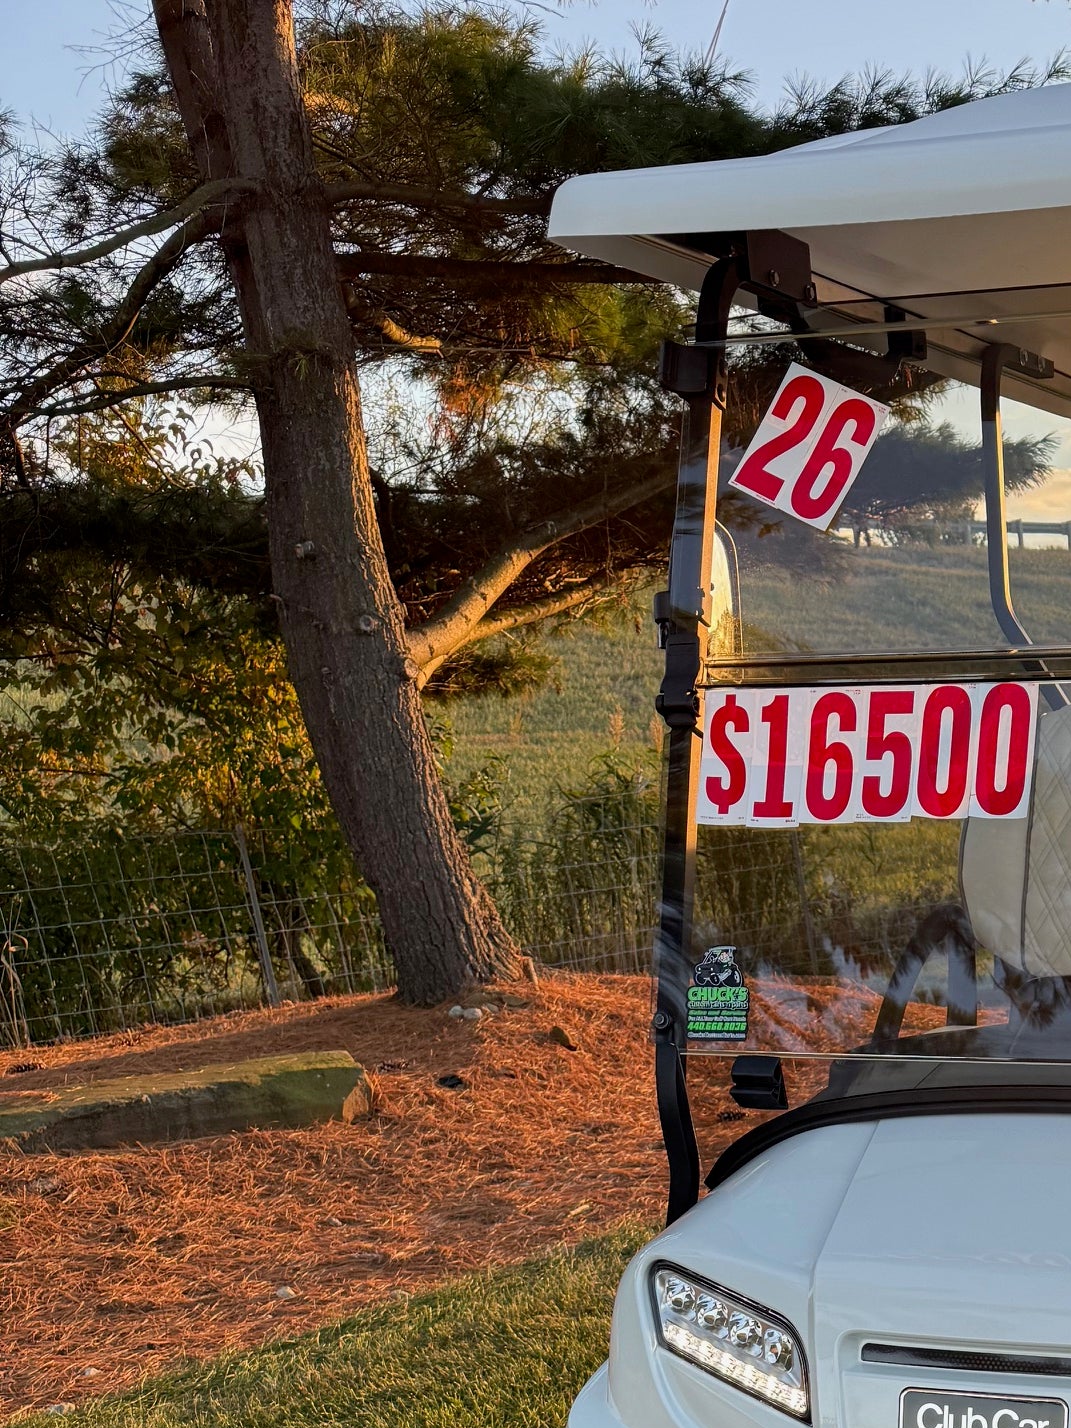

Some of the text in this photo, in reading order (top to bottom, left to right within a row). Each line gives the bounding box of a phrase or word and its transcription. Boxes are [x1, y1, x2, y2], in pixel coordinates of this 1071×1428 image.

[734, 375, 876, 520] 26
[705, 683, 1031, 821] $16500
[687, 986, 748, 1002] CHUCK'S
